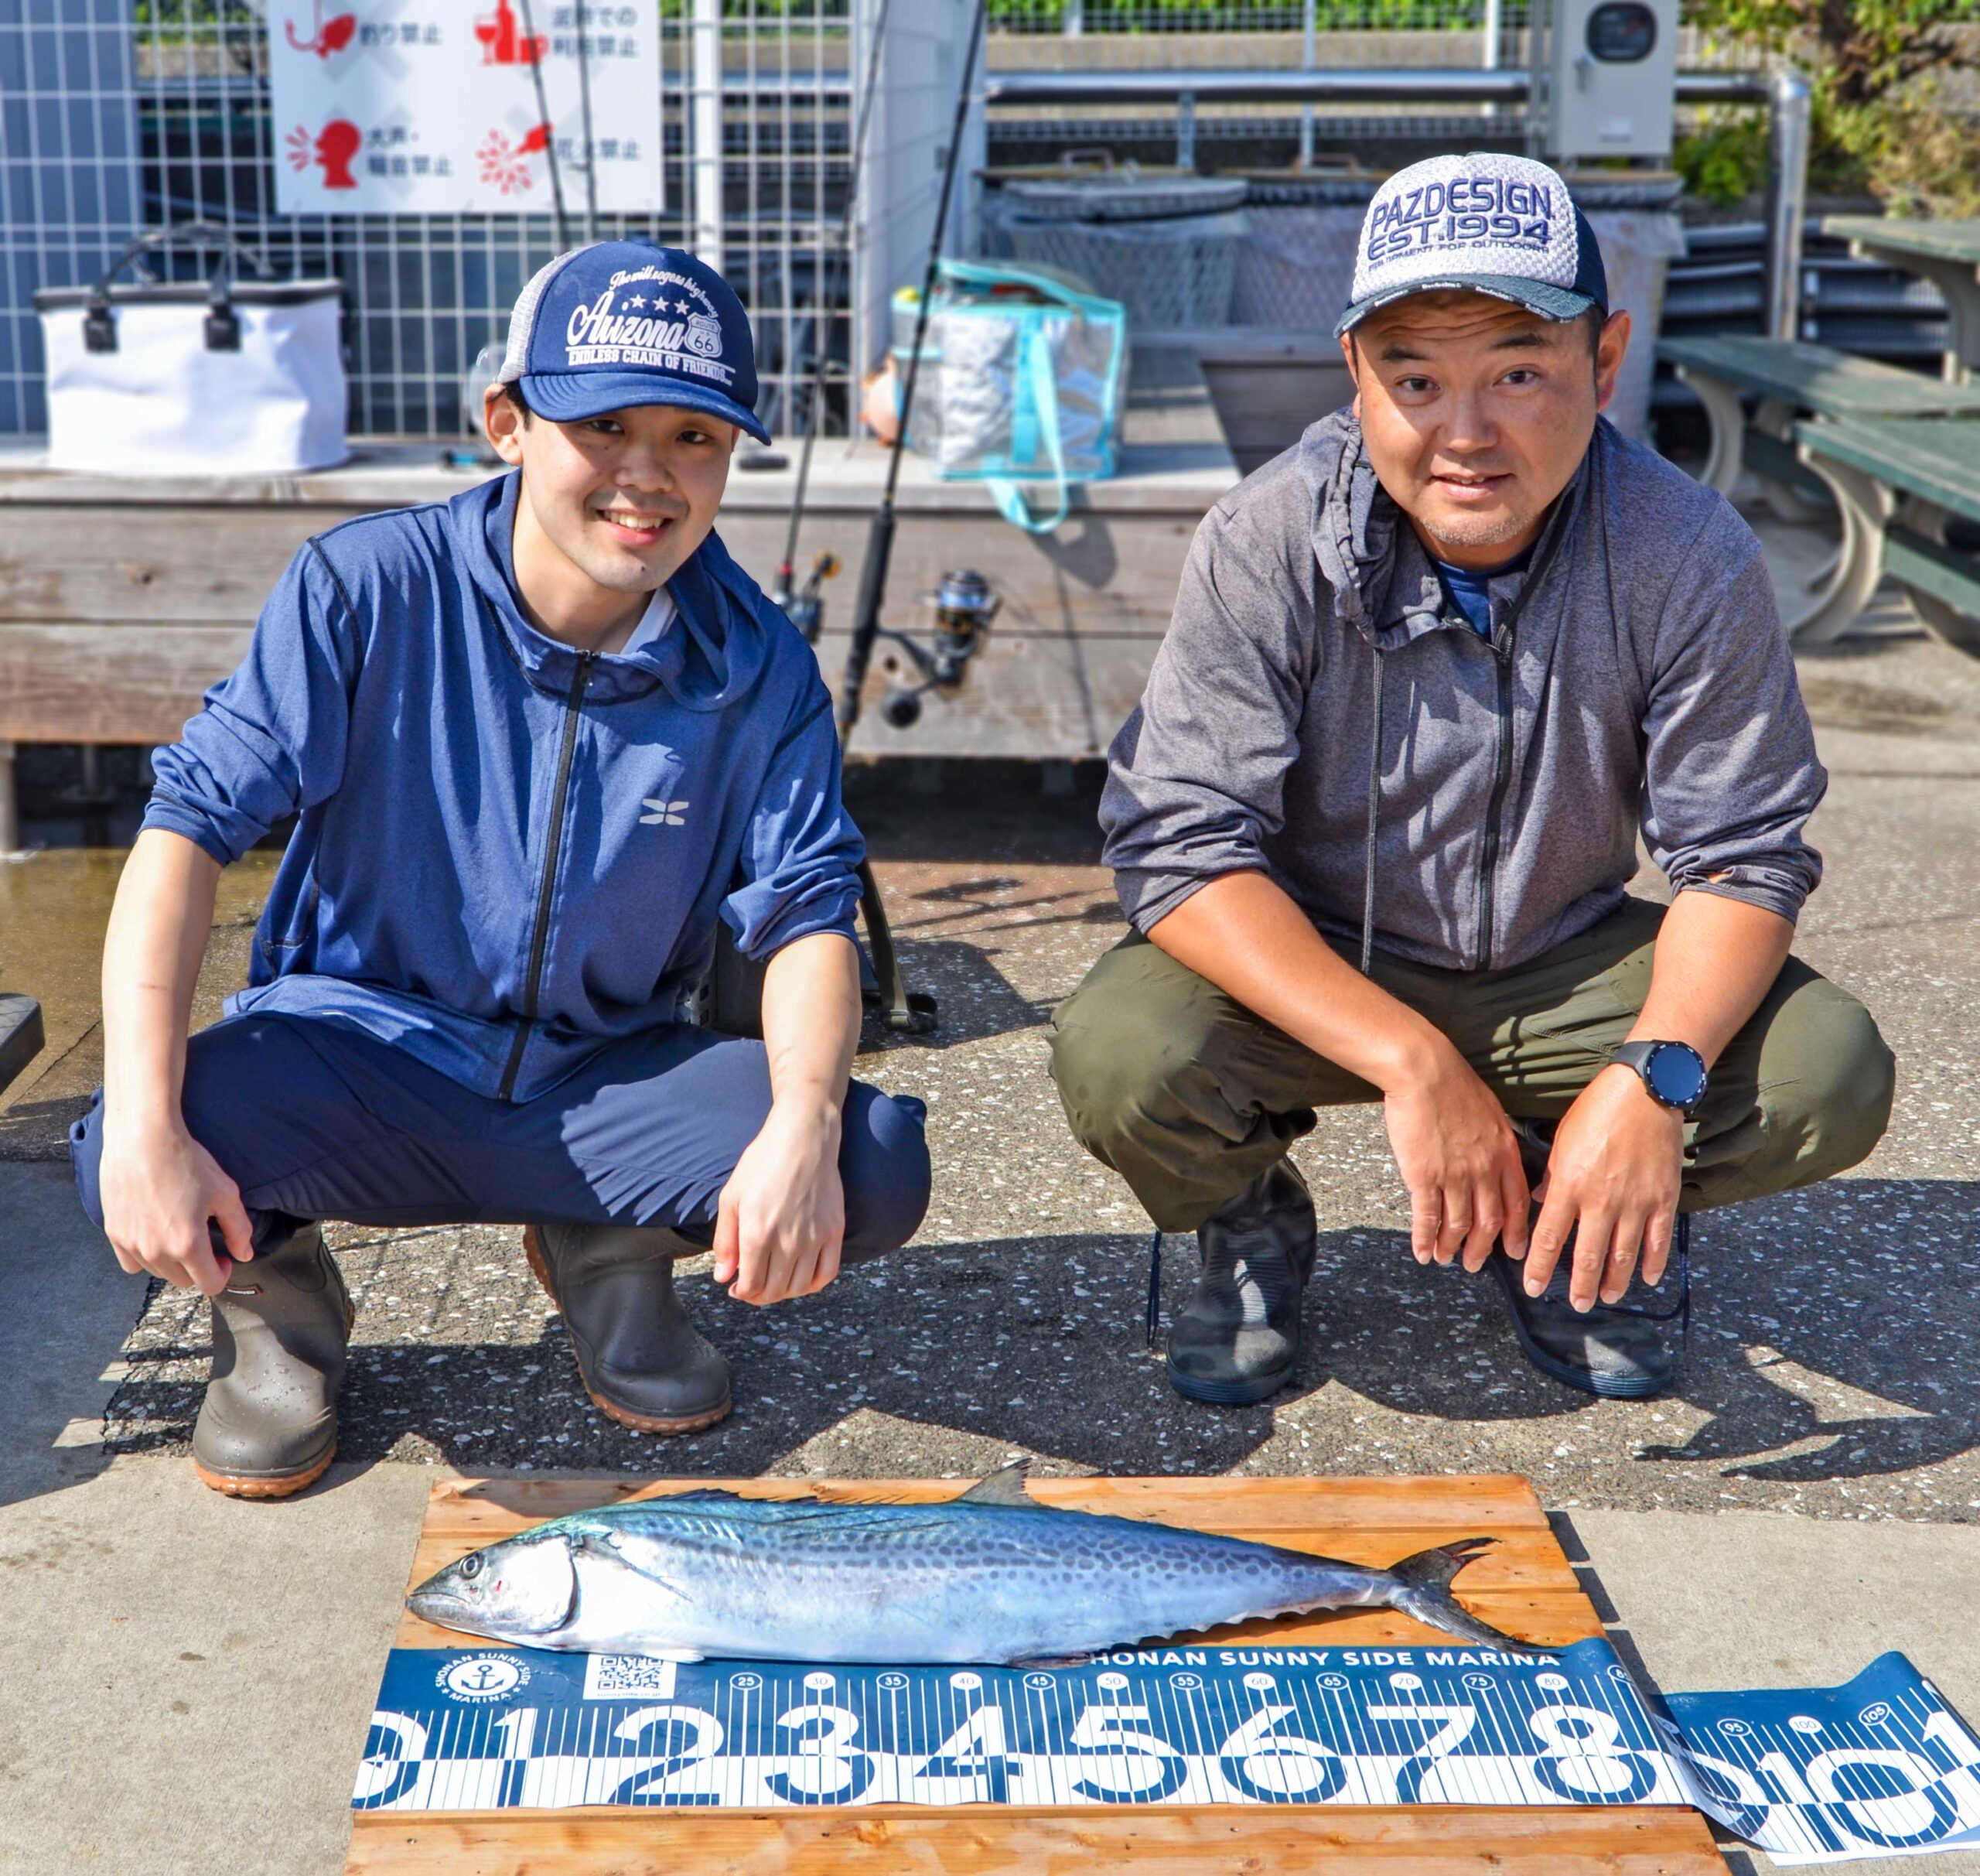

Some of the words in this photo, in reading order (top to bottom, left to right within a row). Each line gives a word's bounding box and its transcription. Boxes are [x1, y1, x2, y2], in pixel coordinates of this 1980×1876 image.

[1368, 177, 1552, 240] PAZDESIGN
[1367, 214, 1552, 261] EST.1994
[567, 291, 688, 350] Arizona
[695, 320, 715, 330] ROUTE
[568, 349, 620, 366] ENDLESS
[622, 350, 662, 367] CHAIN
[665, 355, 680, 369] OF
[694, 335, 714, 352] 66
[435, 1655, 473, 1687] SHONAN
[1090, 1651, 1207, 1666] HONAN
[1220, 1652, 1330, 1666] SUNNY
[1342, 1652, 1415, 1666] SIDE
[1427, 1652, 1561, 1666] MARINA
[449, 1693, 511, 1703] MARINA
[737, 1677, 755, 1686] 25
[812, 1676, 828, 1686] 30
[884, 1676, 902, 1686] 35
[958, 1676, 975, 1686] 40
[1031, 1676, 1048, 1686] 45
[1105, 1676, 1121, 1686] 50
[1177, 1676, 1193, 1686] 55
[1251, 1676, 1268, 1686] 60
[1323, 1676, 1341, 1686] 65
[1398, 1676, 1415, 1686] 70
[1470, 1676, 1487, 1686] 75
[1544, 1676, 1561, 1686] 80
[1724, 1722, 1743, 1732] 95
[1794, 1721, 1817, 1730] 100
[1863, 1707, 1886, 1723] 105
[494, 1707, 538, 1809] 1
[608, 1705, 724, 1807] 2
[764, 1705, 876, 1806] 3
[914, 1705, 1024, 1804] 4
[1069, 1706, 1188, 1805] 5
[1220, 1706, 1347, 1805] 6
[1366, 1706, 1476, 1805] 7
[1530, 1705, 1656, 1805] 8
